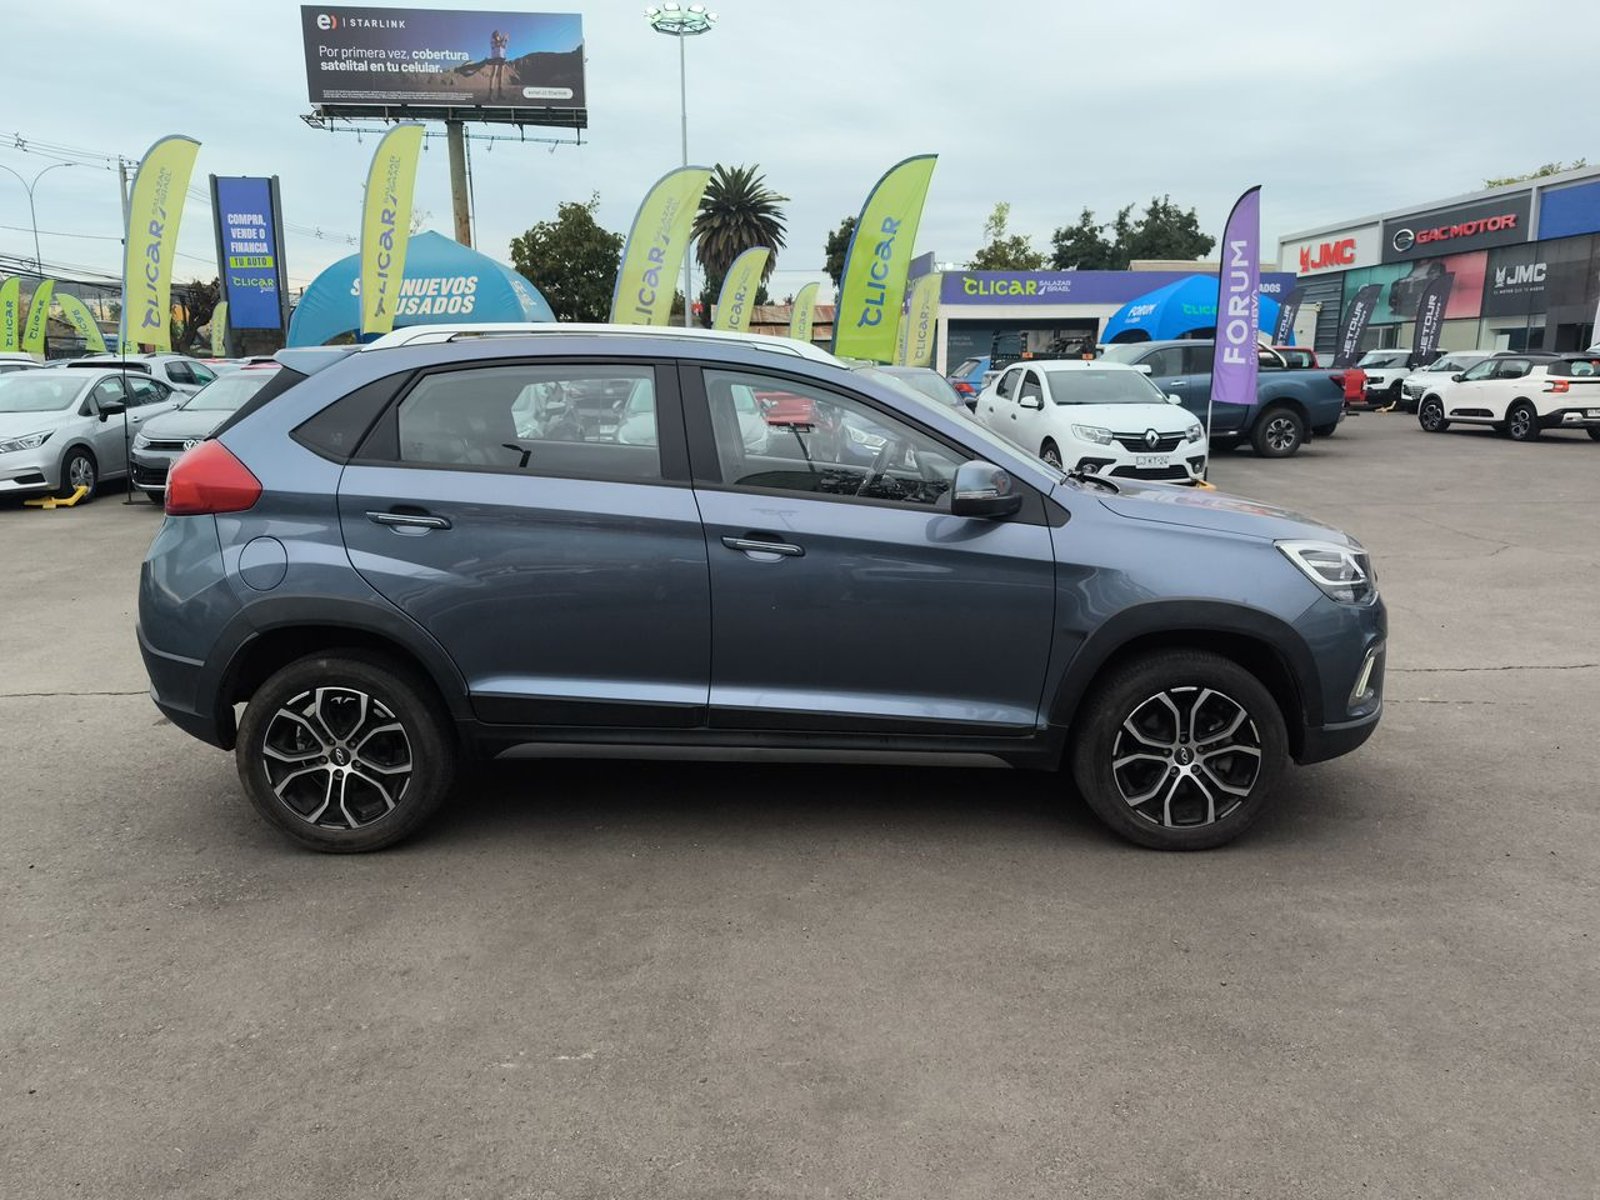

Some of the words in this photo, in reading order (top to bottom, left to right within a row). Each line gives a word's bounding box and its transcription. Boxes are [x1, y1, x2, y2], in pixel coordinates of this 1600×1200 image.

[350, 18, 406, 29] STARLINK
[319, 46, 339, 58] Por
[341, 46, 386, 60] primera
[387, 50, 410, 60] vez,
[412, 48, 469, 61] cobertura
[320, 60, 368, 72] satelital
[370, 63, 384, 72] en
[386, 62, 399, 72] tu
[401, 62, 443, 73] celular.
[228, 214, 266, 227] COMPRA,
[230, 228, 258, 239] VENDE
[259, 228, 265, 239] O
[231, 242, 268, 253] FINANCIA
[1310, 238, 1356, 269] JMC
[234, 258, 245, 266] TU
[247, 258, 267, 266] AUTO
[1506, 262, 1547, 284] JMC
[350, 276, 478, 296] SNUEVOS
[1224, 240, 1250, 364] FORUM
[1344, 302, 1364, 358] JETOUR
[1421, 295, 1437, 356] JETOUR
